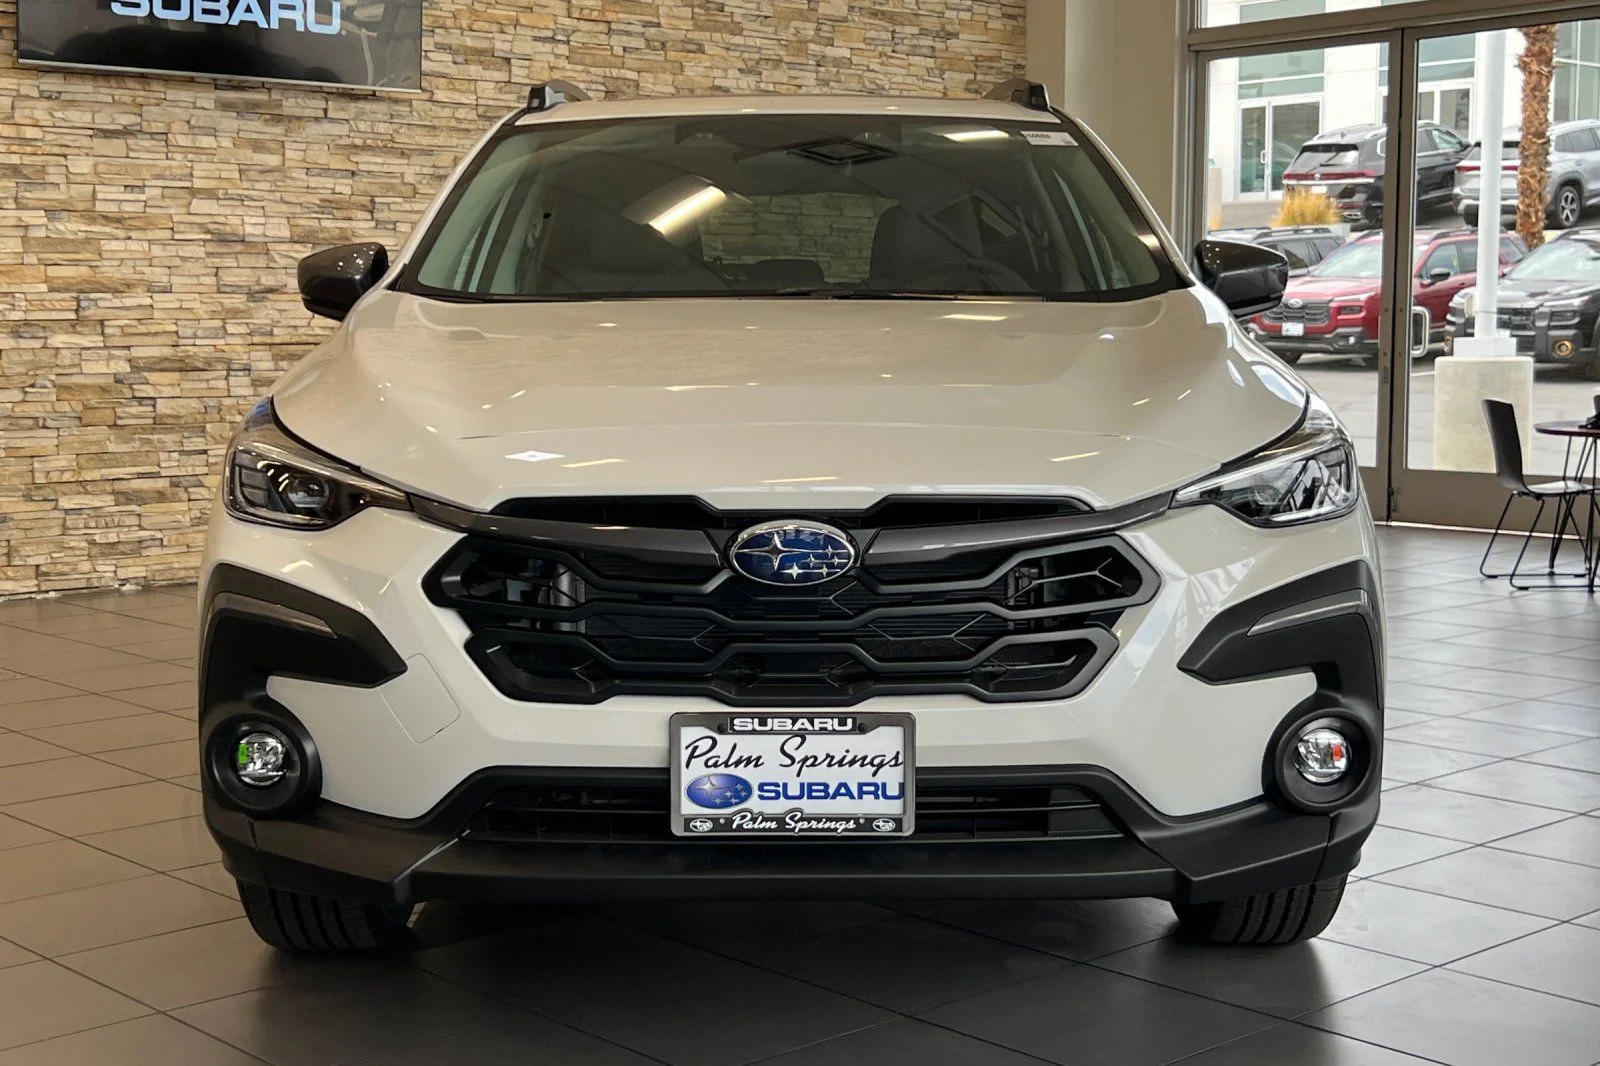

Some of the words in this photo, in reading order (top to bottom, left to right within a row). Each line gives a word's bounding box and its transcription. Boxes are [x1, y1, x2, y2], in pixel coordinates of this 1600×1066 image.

[733, 718, 853, 731] SUBARU
[685, 735, 764, 769] Palm
[779, 734, 904, 777] Springs
[757, 781, 904, 800] SUBARU
[732, 812, 778, 830] Palm
[784, 812, 857, 834] Springs
